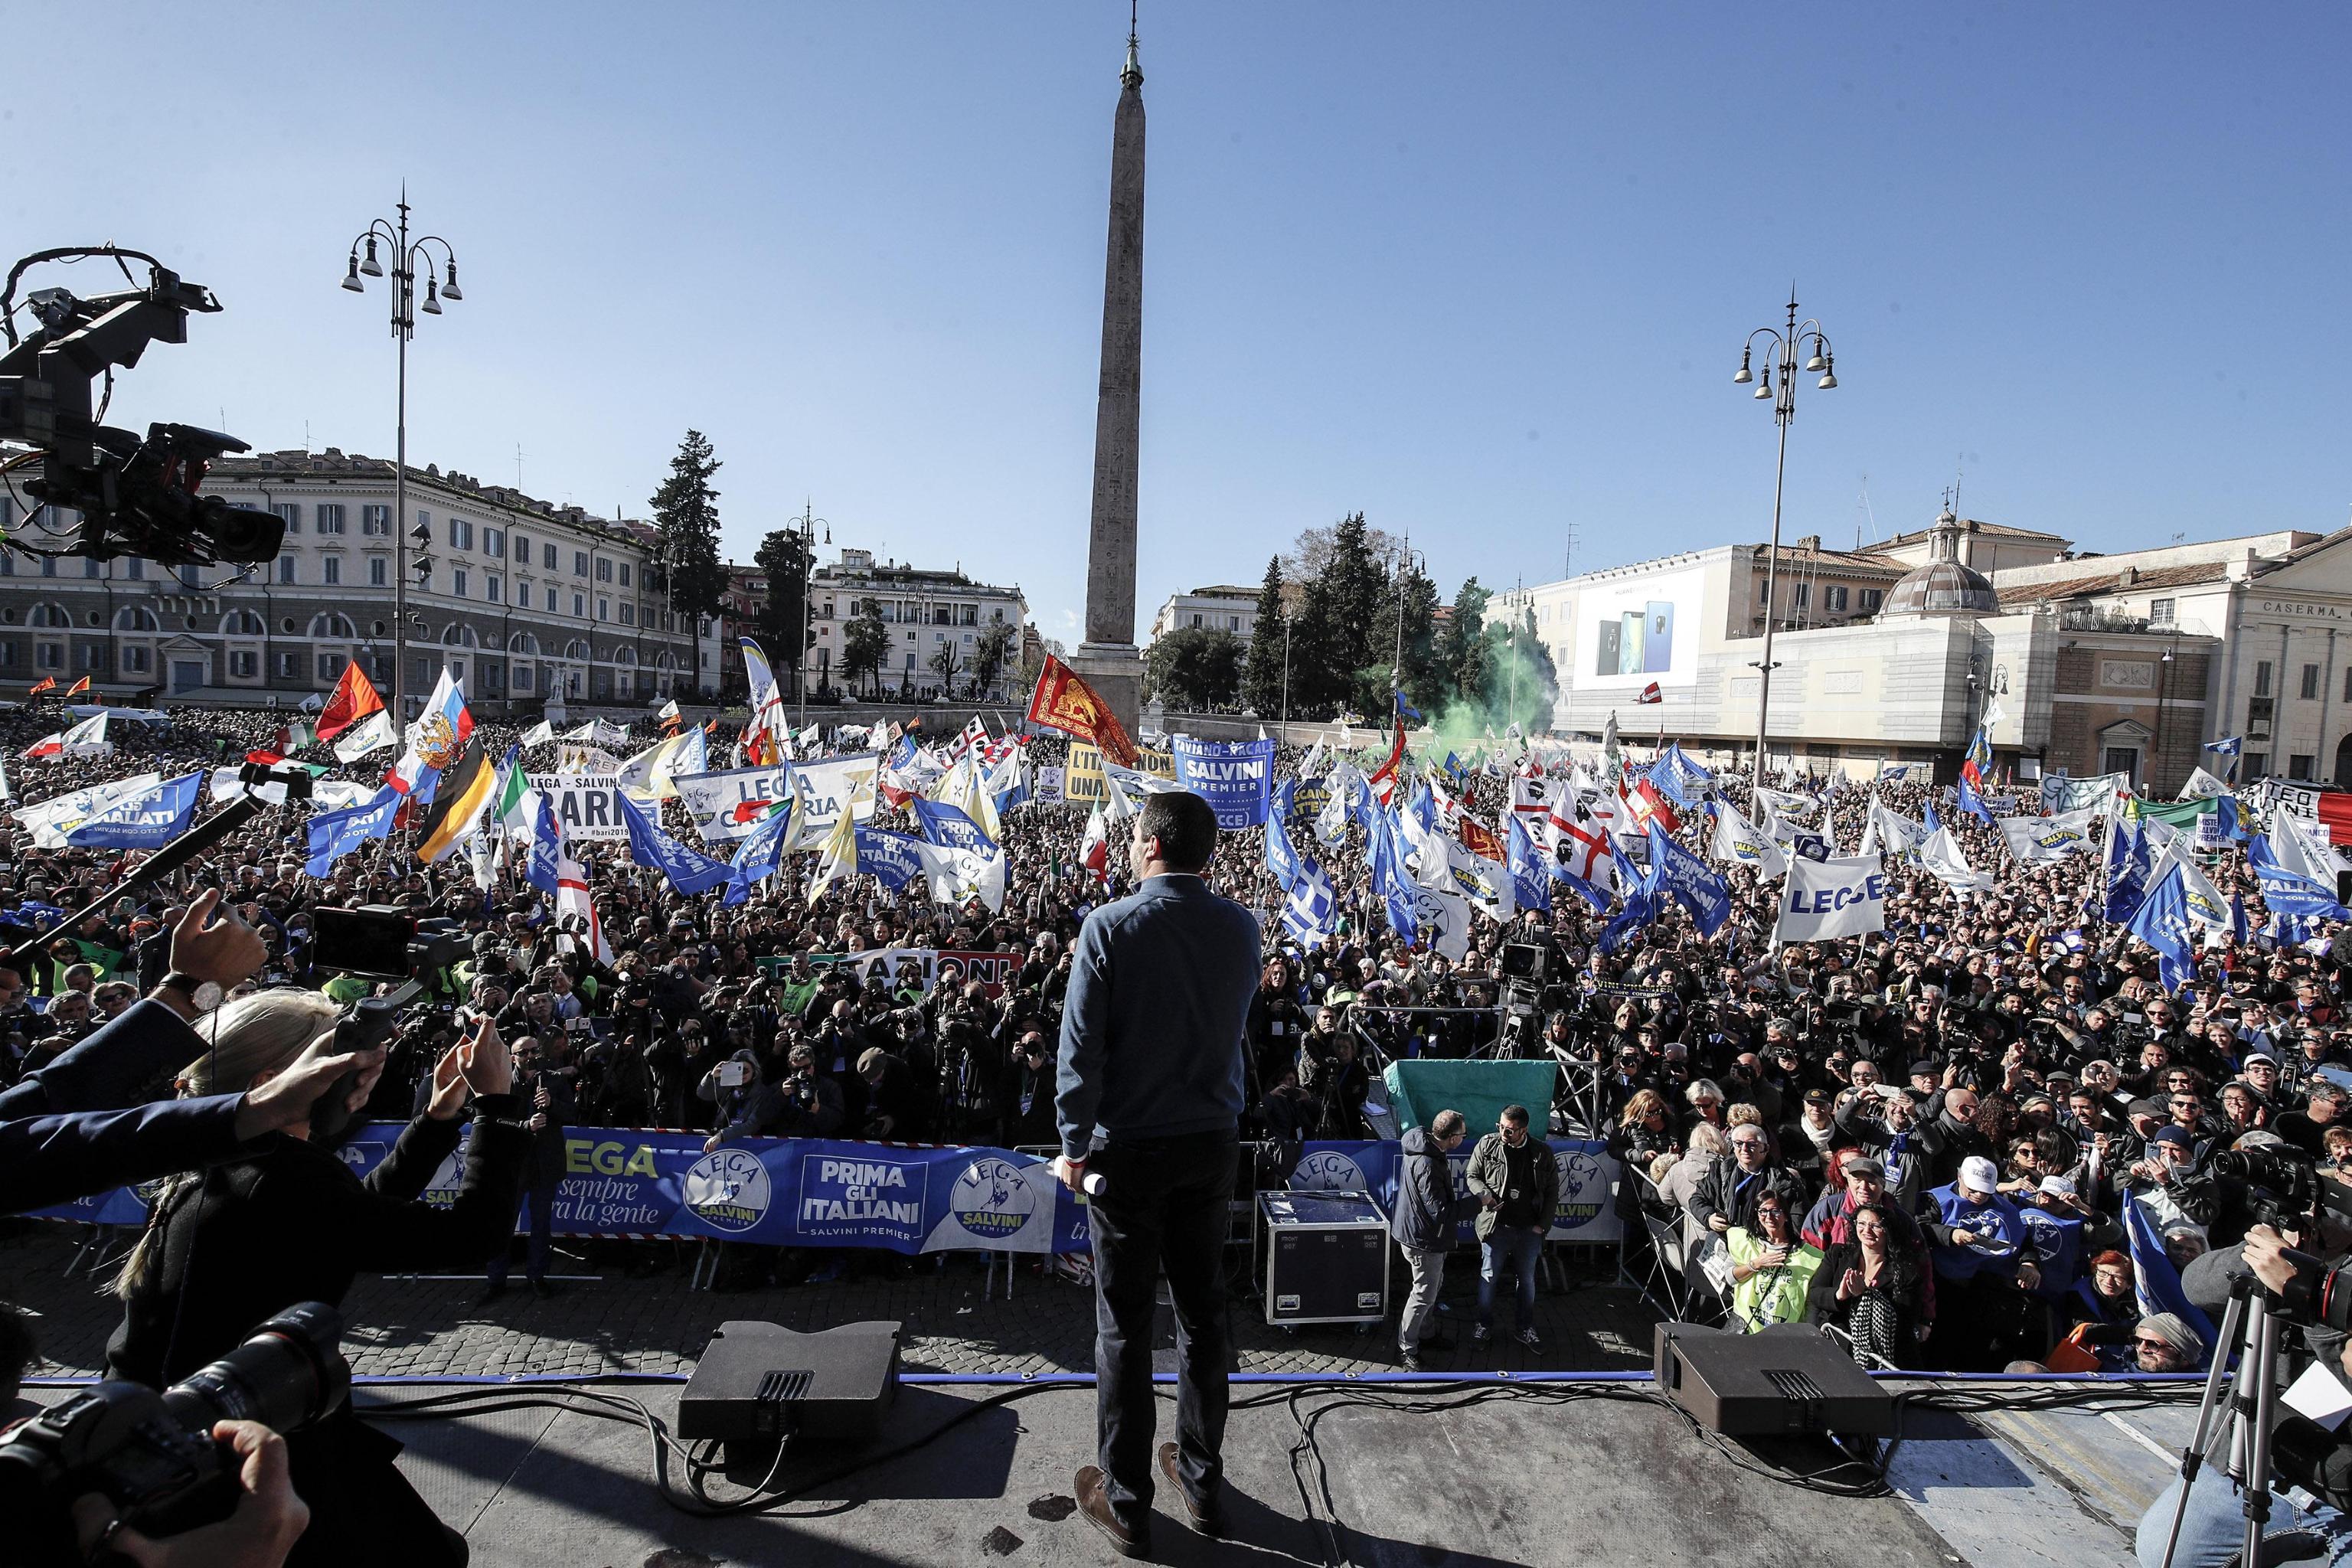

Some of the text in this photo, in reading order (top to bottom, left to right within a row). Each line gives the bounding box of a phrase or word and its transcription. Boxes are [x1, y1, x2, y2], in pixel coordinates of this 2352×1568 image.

[2263, 601, 2335, 617] CASERMA
[1136, 753, 1170, 771] NON
[1187, 760, 1263, 781] SALVINI
[531, 777, 561, 789] LEGA
[1070, 776, 1104, 797] UNA
[1193, 780, 1256, 792] PREMIER
[691, 812, 712, 822] ALVINI
[2198, 818, 2218, 827] MISTE
[2040, 831, 2079, 847] SALVINI
[883, 842, 903, 856] GLI
[1665, 848, 1717, 887] PRIMA
[565, 1138, 659, 1179] EGA
[694, 1153, 760, 1184] LEGA
[821, 1161, 906, 1187] PRIMA
[962, 1163, 1025, 1191] LEGA
[1295, 1156, 1356, 1184] LEGA
[1555, 1155, 1599, 1182] EGA
[558, 1177, 639, 1204] sempre
[845, 1185, 877, 1201] GLI
[550, 1197, 659, 1227] ra la gente
[698, 1204, 756, 1222] SALVINI
[804, 1198, 920, 1224] ITALIANI
[1555, 1204, 1596, 1217] ALVINI
[706, 1215, 749, 1227] PREMIER
[962, 1212, 1023, 1228] SALVINI
[969, 1224, 1014, 1233] PREMIER
[2024, 1216, 2058, 1239] EGA
[810, 1227, 910, 1241] SALVINI PREMIER
[1070, 1221, 1086, 1240] tr
